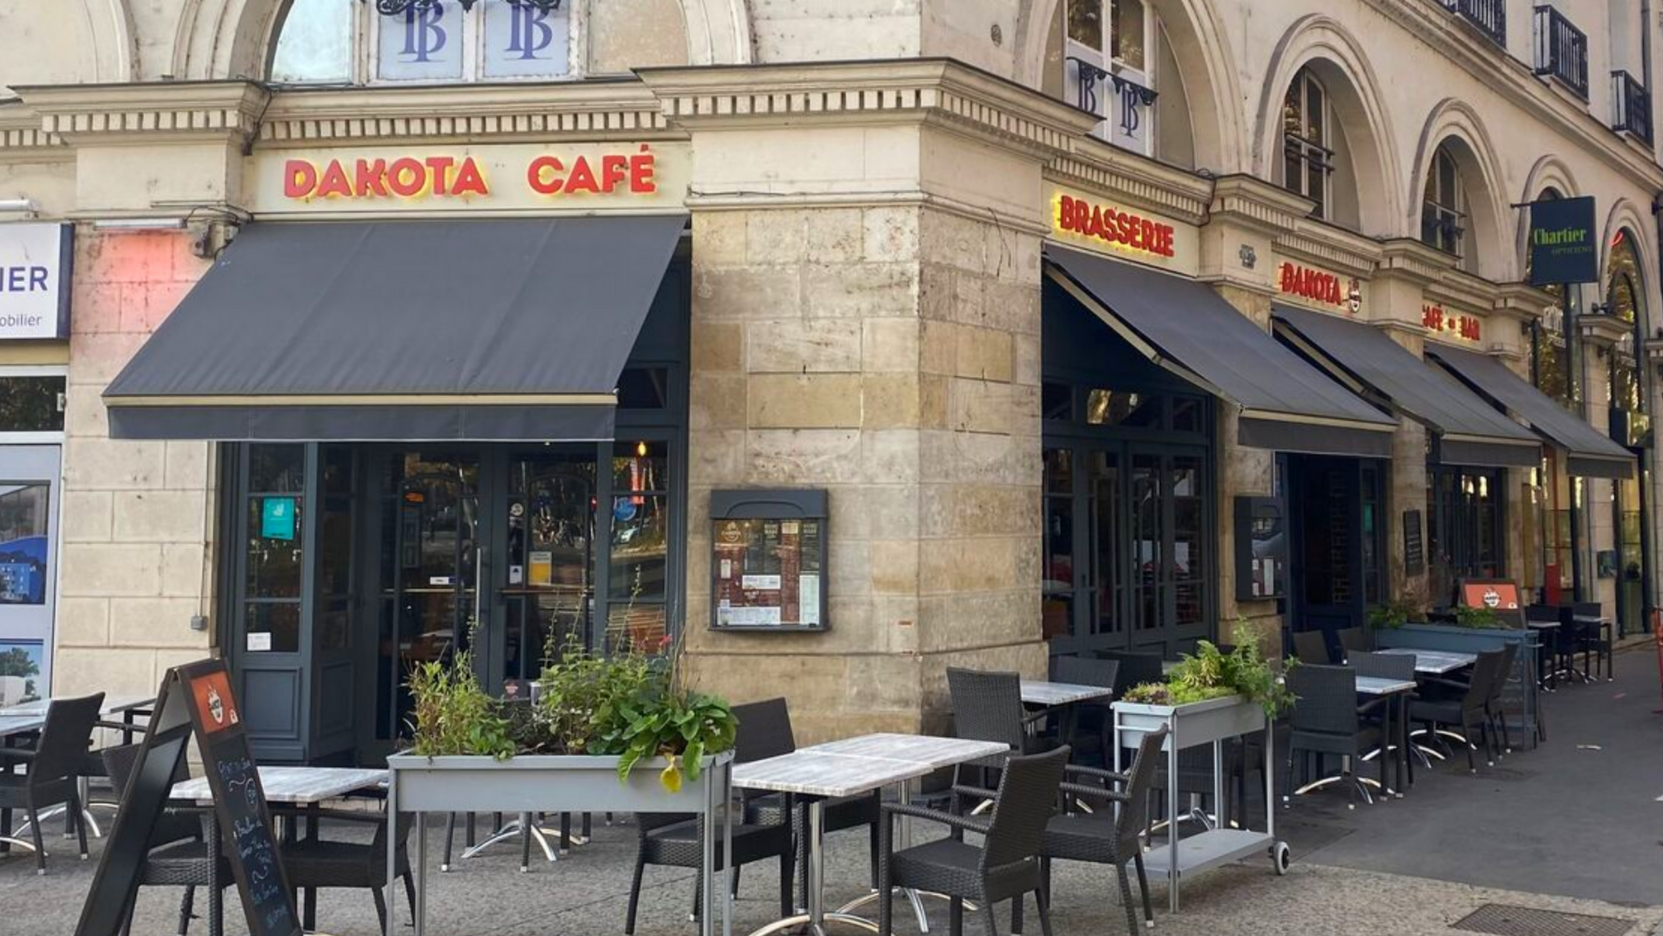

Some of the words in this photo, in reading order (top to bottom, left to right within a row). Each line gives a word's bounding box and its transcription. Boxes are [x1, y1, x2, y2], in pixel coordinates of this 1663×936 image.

[283, 155, 489, 199] DAKOTA
[527, 144, 656, 195] CAFÉ
[1060, 195, 1174, 257] BRASSERIE
[1533, 227, 1587, 245] Chartier
[1281, 261, 1342, 306] DAKOTA
[1459, 315, 1480, 341] BAR
